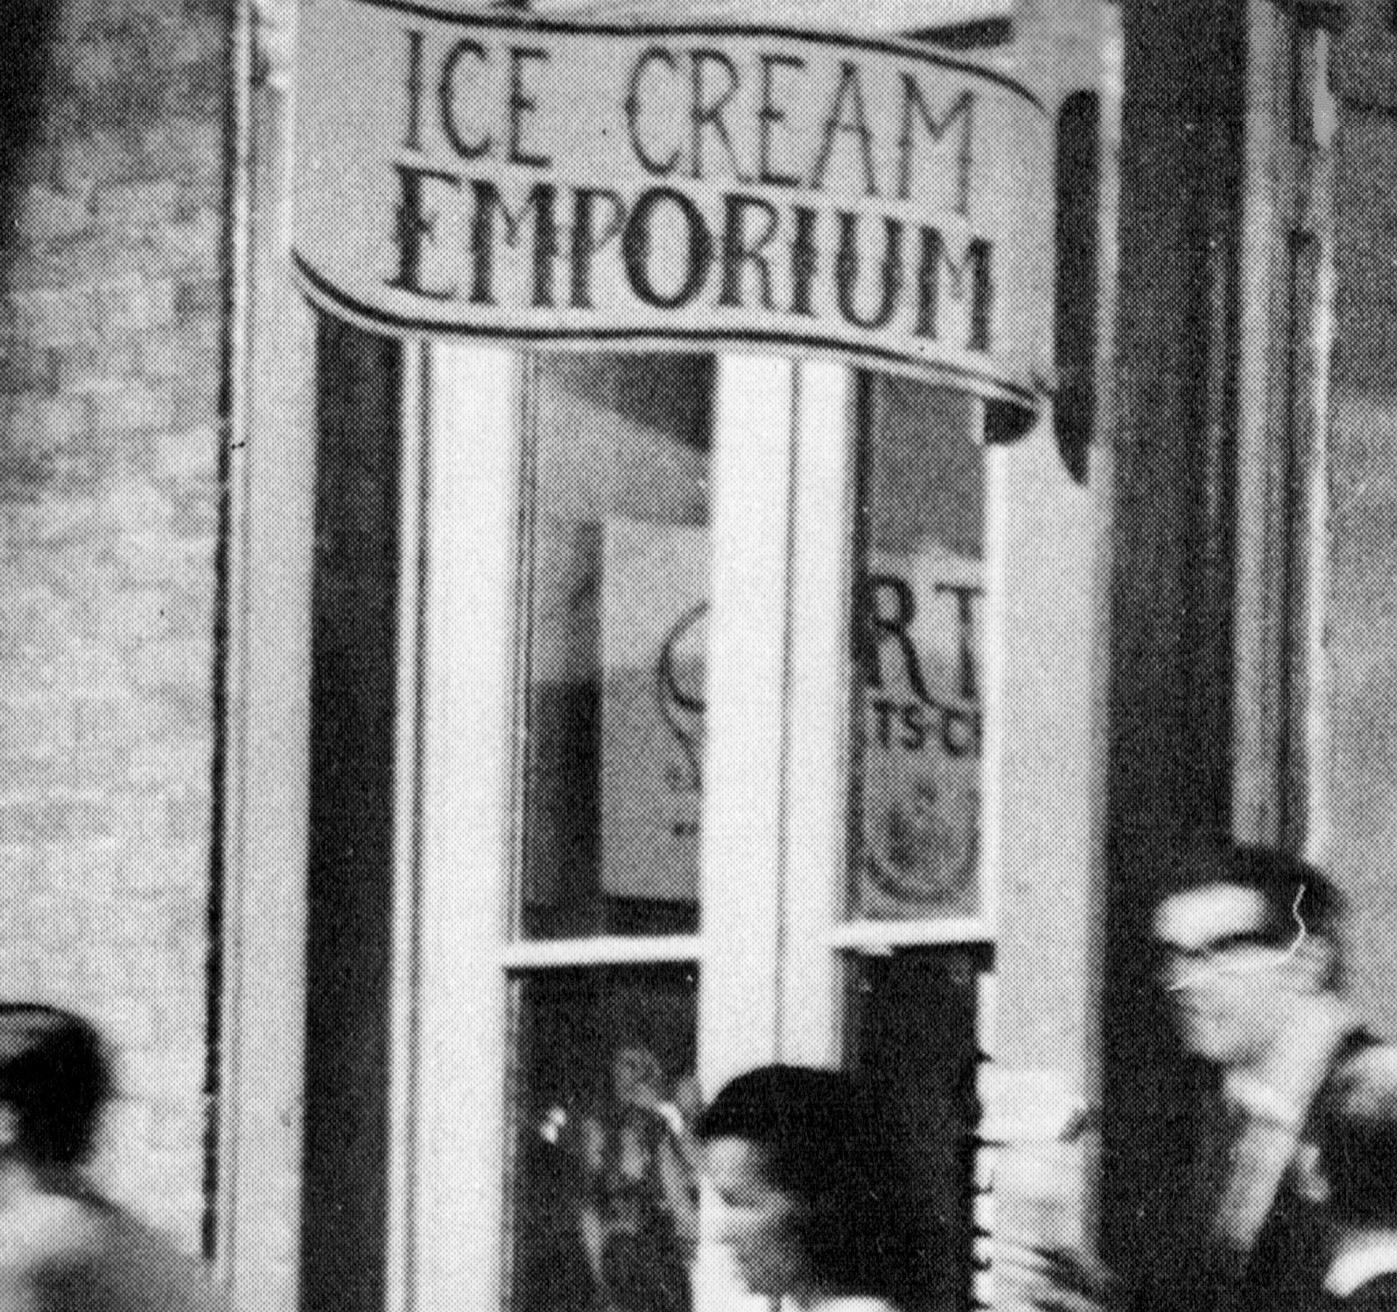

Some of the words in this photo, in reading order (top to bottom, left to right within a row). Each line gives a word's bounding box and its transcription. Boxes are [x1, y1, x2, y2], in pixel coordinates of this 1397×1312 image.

[402, 29, 552, 168] ICE
[624, 45, 978, 217] CREAM
[383, 161, 996, 354] EMPORIUM
